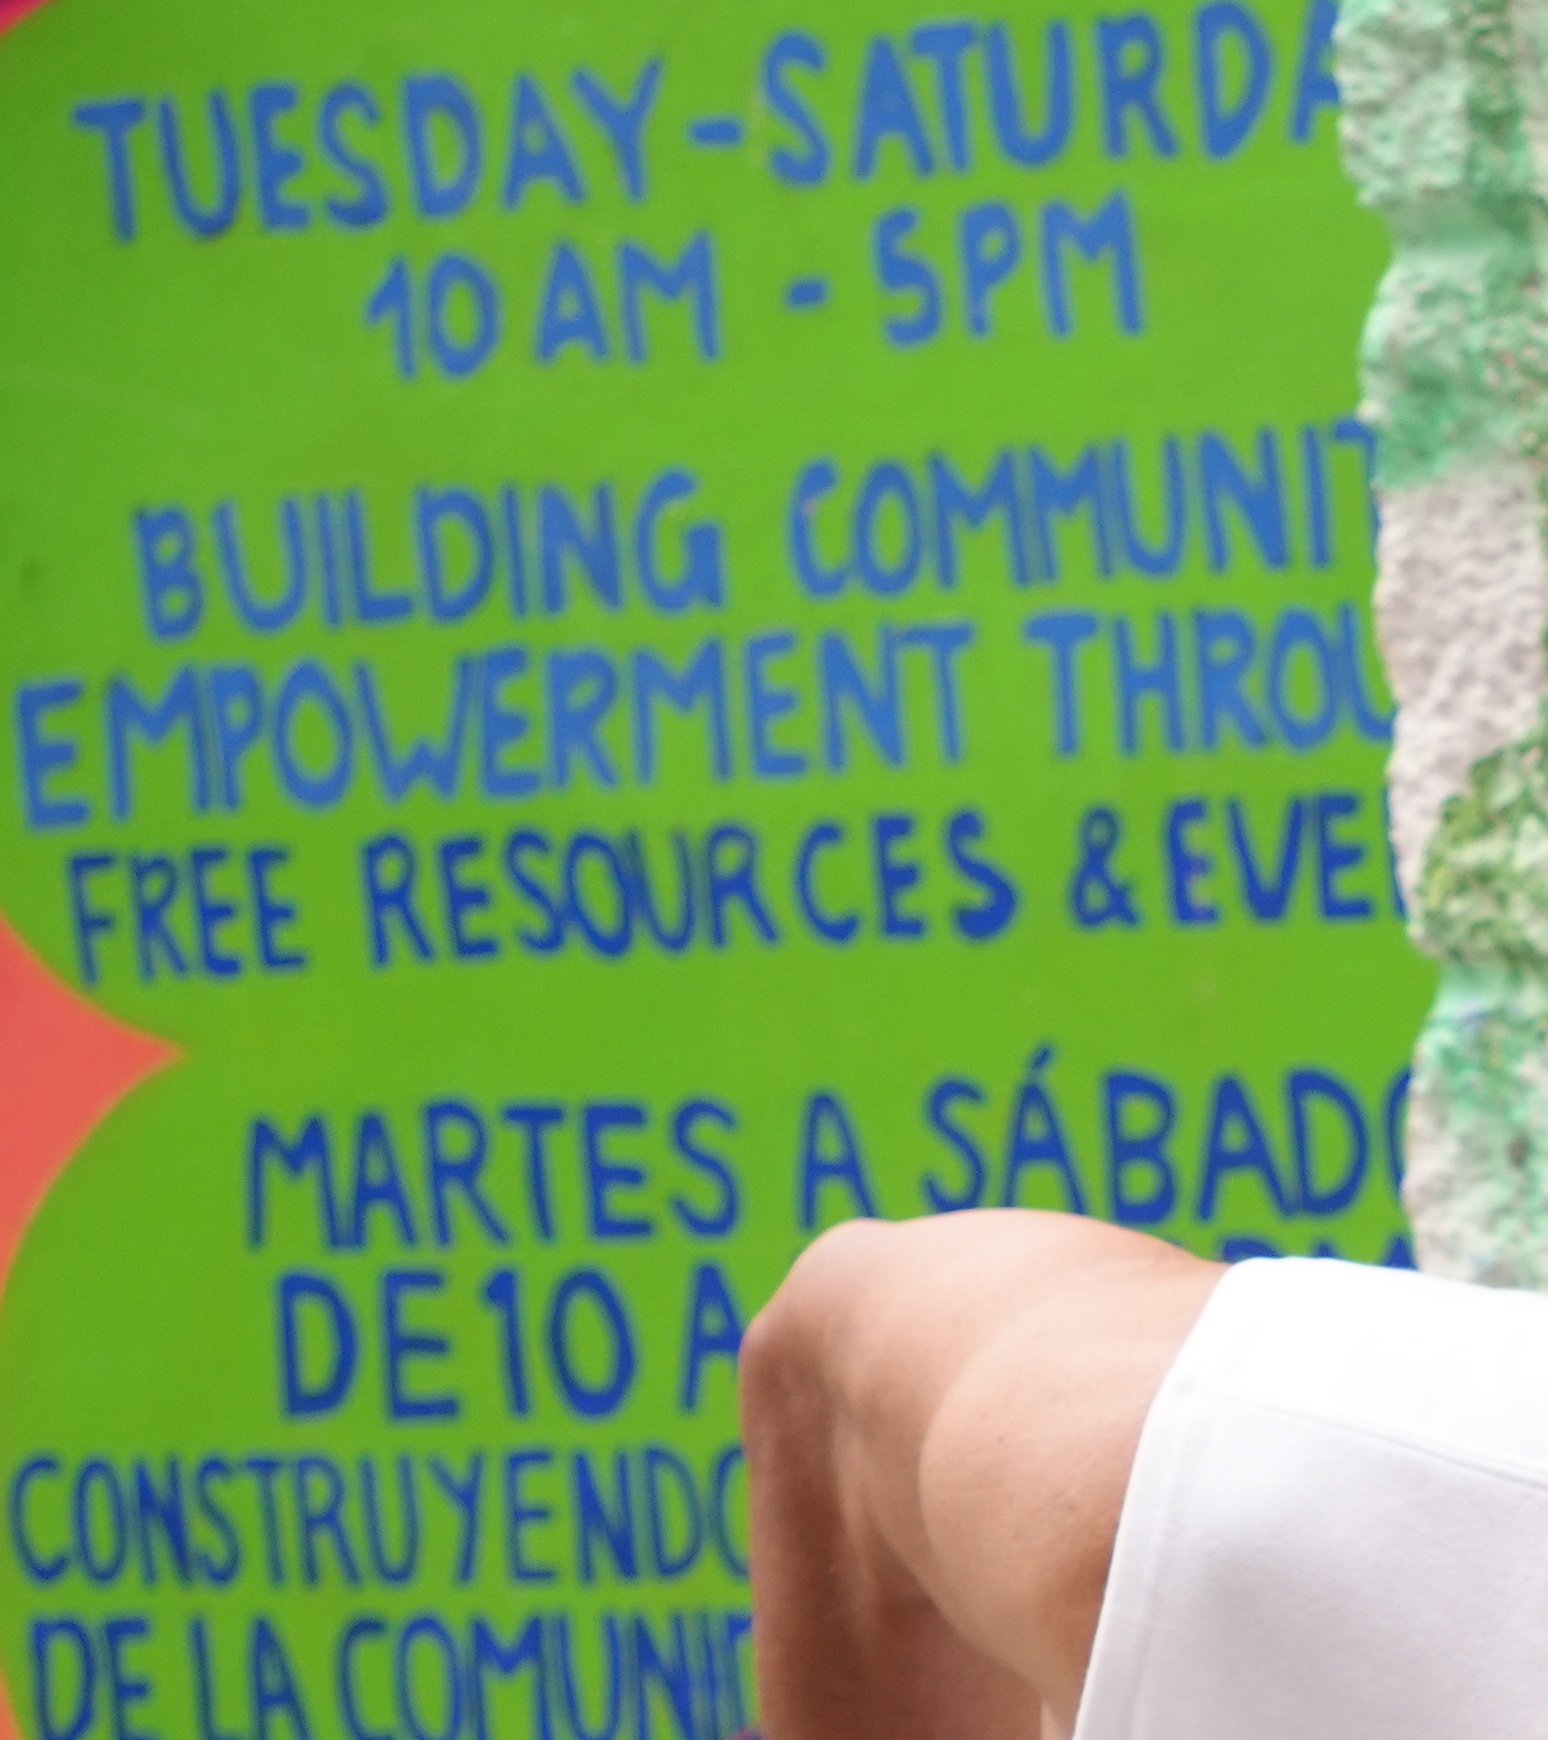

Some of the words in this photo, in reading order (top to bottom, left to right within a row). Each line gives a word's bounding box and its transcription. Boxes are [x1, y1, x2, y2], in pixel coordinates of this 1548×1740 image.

[533, 231, 723, 365] AM
[870, 190, 1146, 350] 5PM
[131, 466, 729, 644] BUILDING
[13, 619, 977, 833] EMPOWERMENT
[66, 843, 309, 984] FREE
[359, 807, 1022, 969] RESOURCES
[1161, 789, 1411, 929] EVE
[245, 1095, 743, 1254] MARTES
[795, 1090, 880, 1232] A
